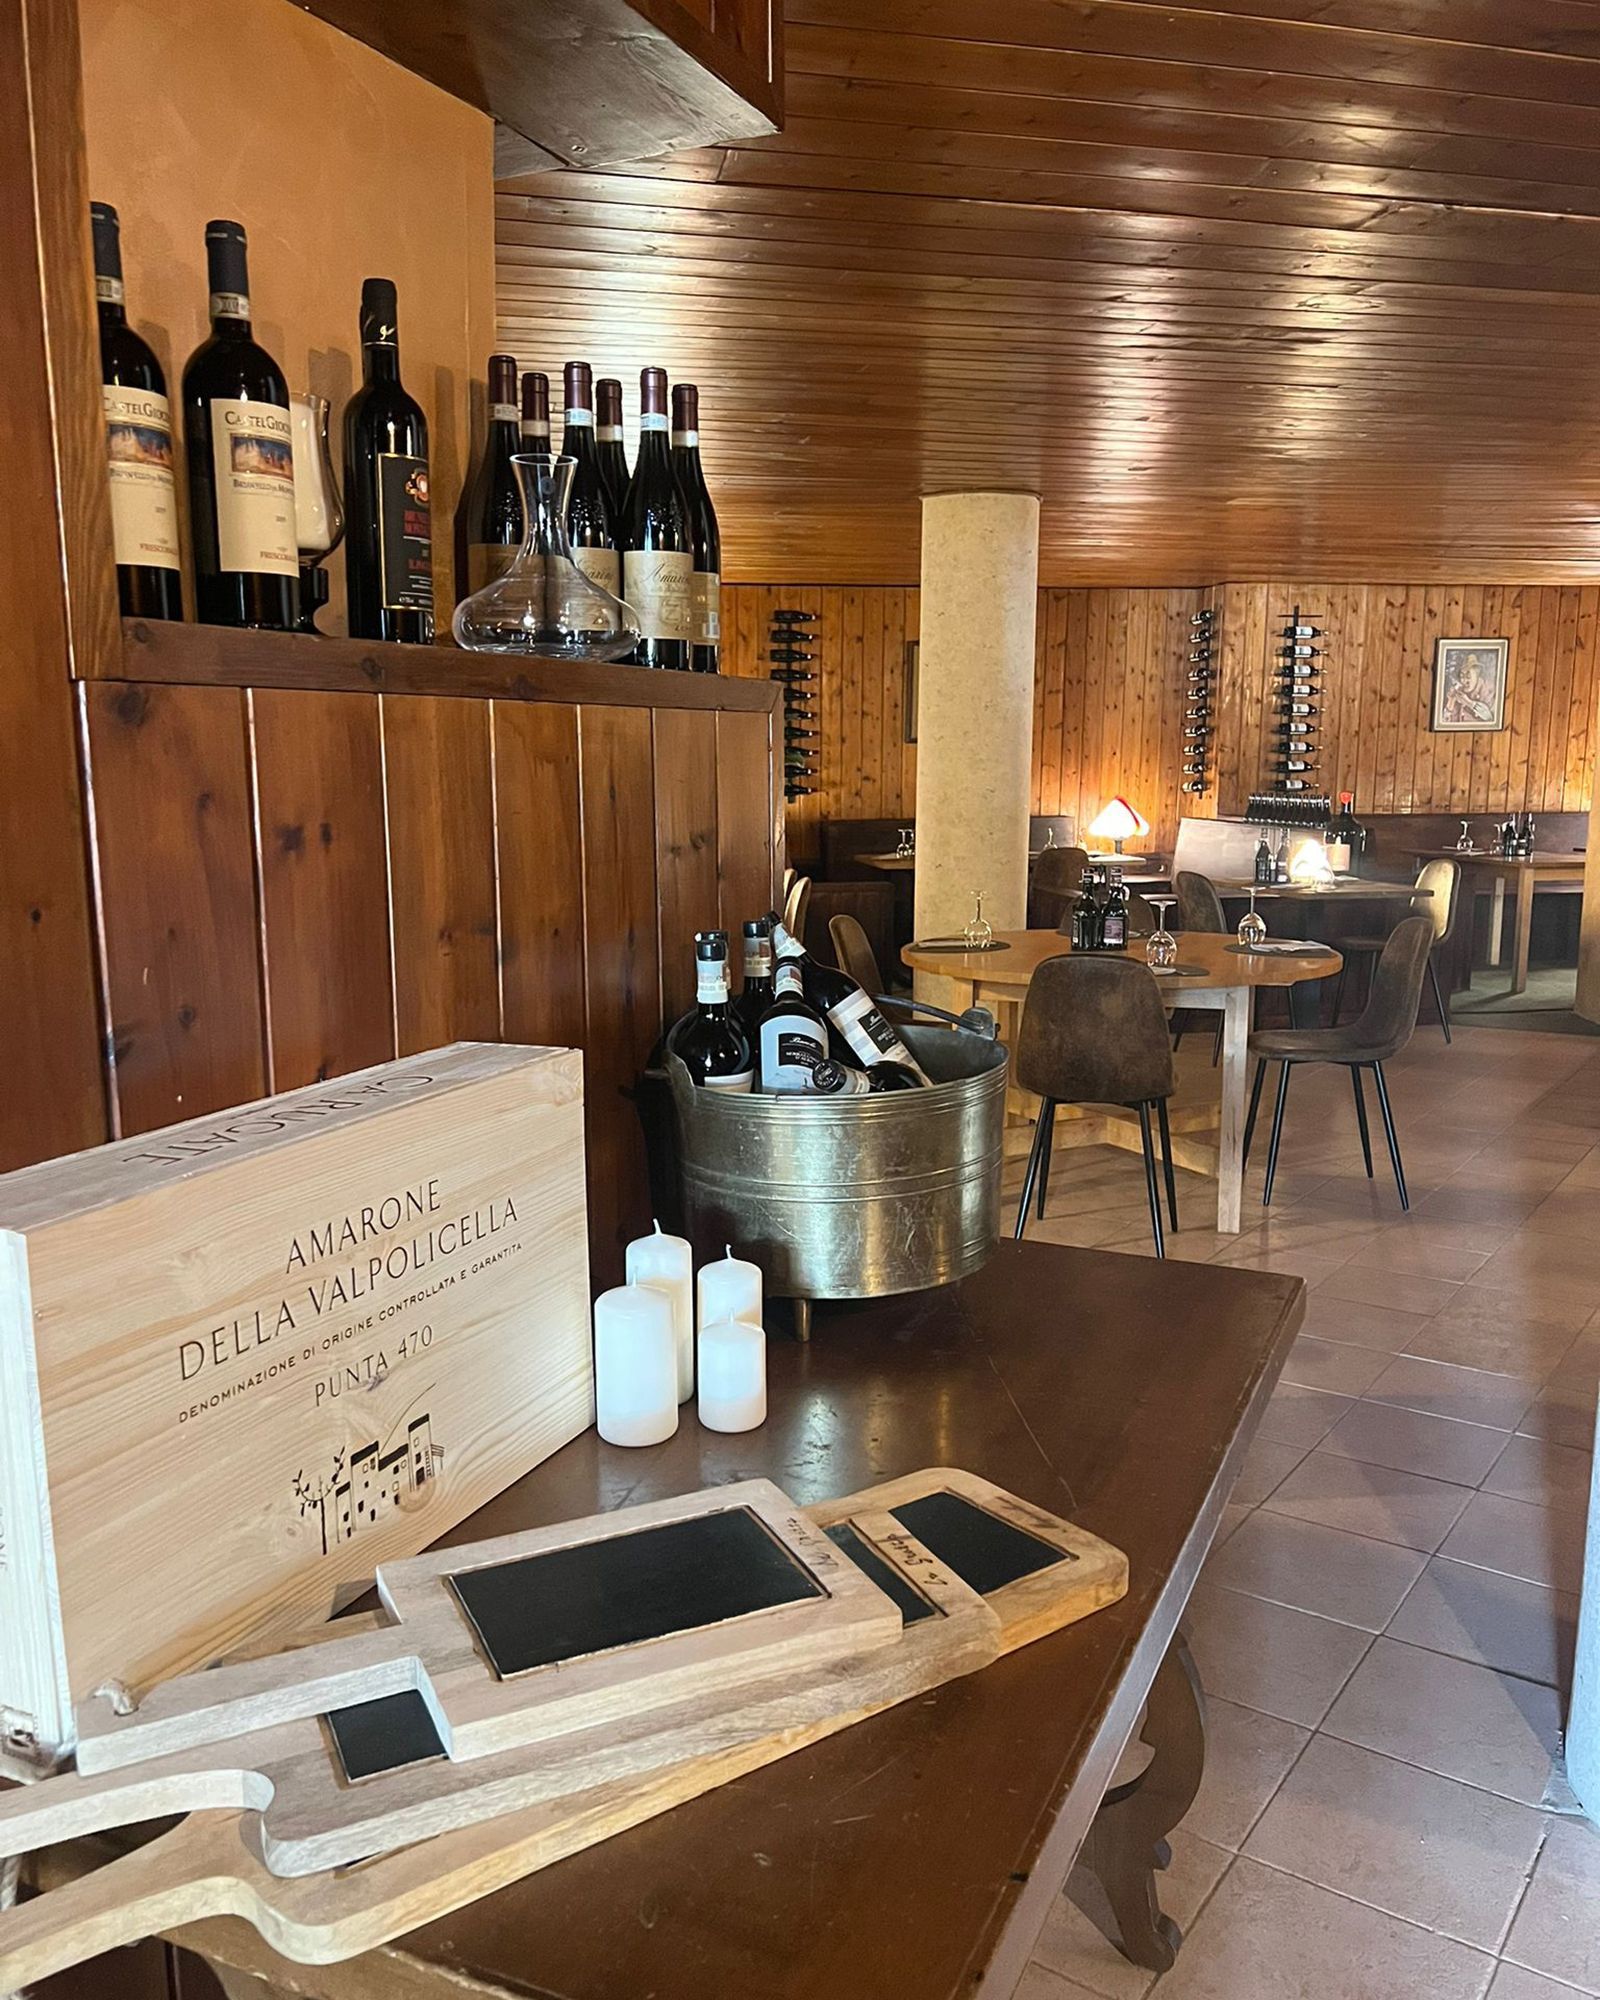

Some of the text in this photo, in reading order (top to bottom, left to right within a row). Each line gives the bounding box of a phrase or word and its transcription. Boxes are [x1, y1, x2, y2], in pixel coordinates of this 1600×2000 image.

[122, 1099, 363, 1166] RUGATE
[286, 1178, 441, 1275] AMARONE
[179, 1197, 519, 1382] DELLA VALPOLICELLA
[179, 1242, 524, 1424] DENOMINAZIONE DI ORIGINE CONTROLLATA E GARANTITA
[315, 1324, 434, 1408] PUNTA 470
